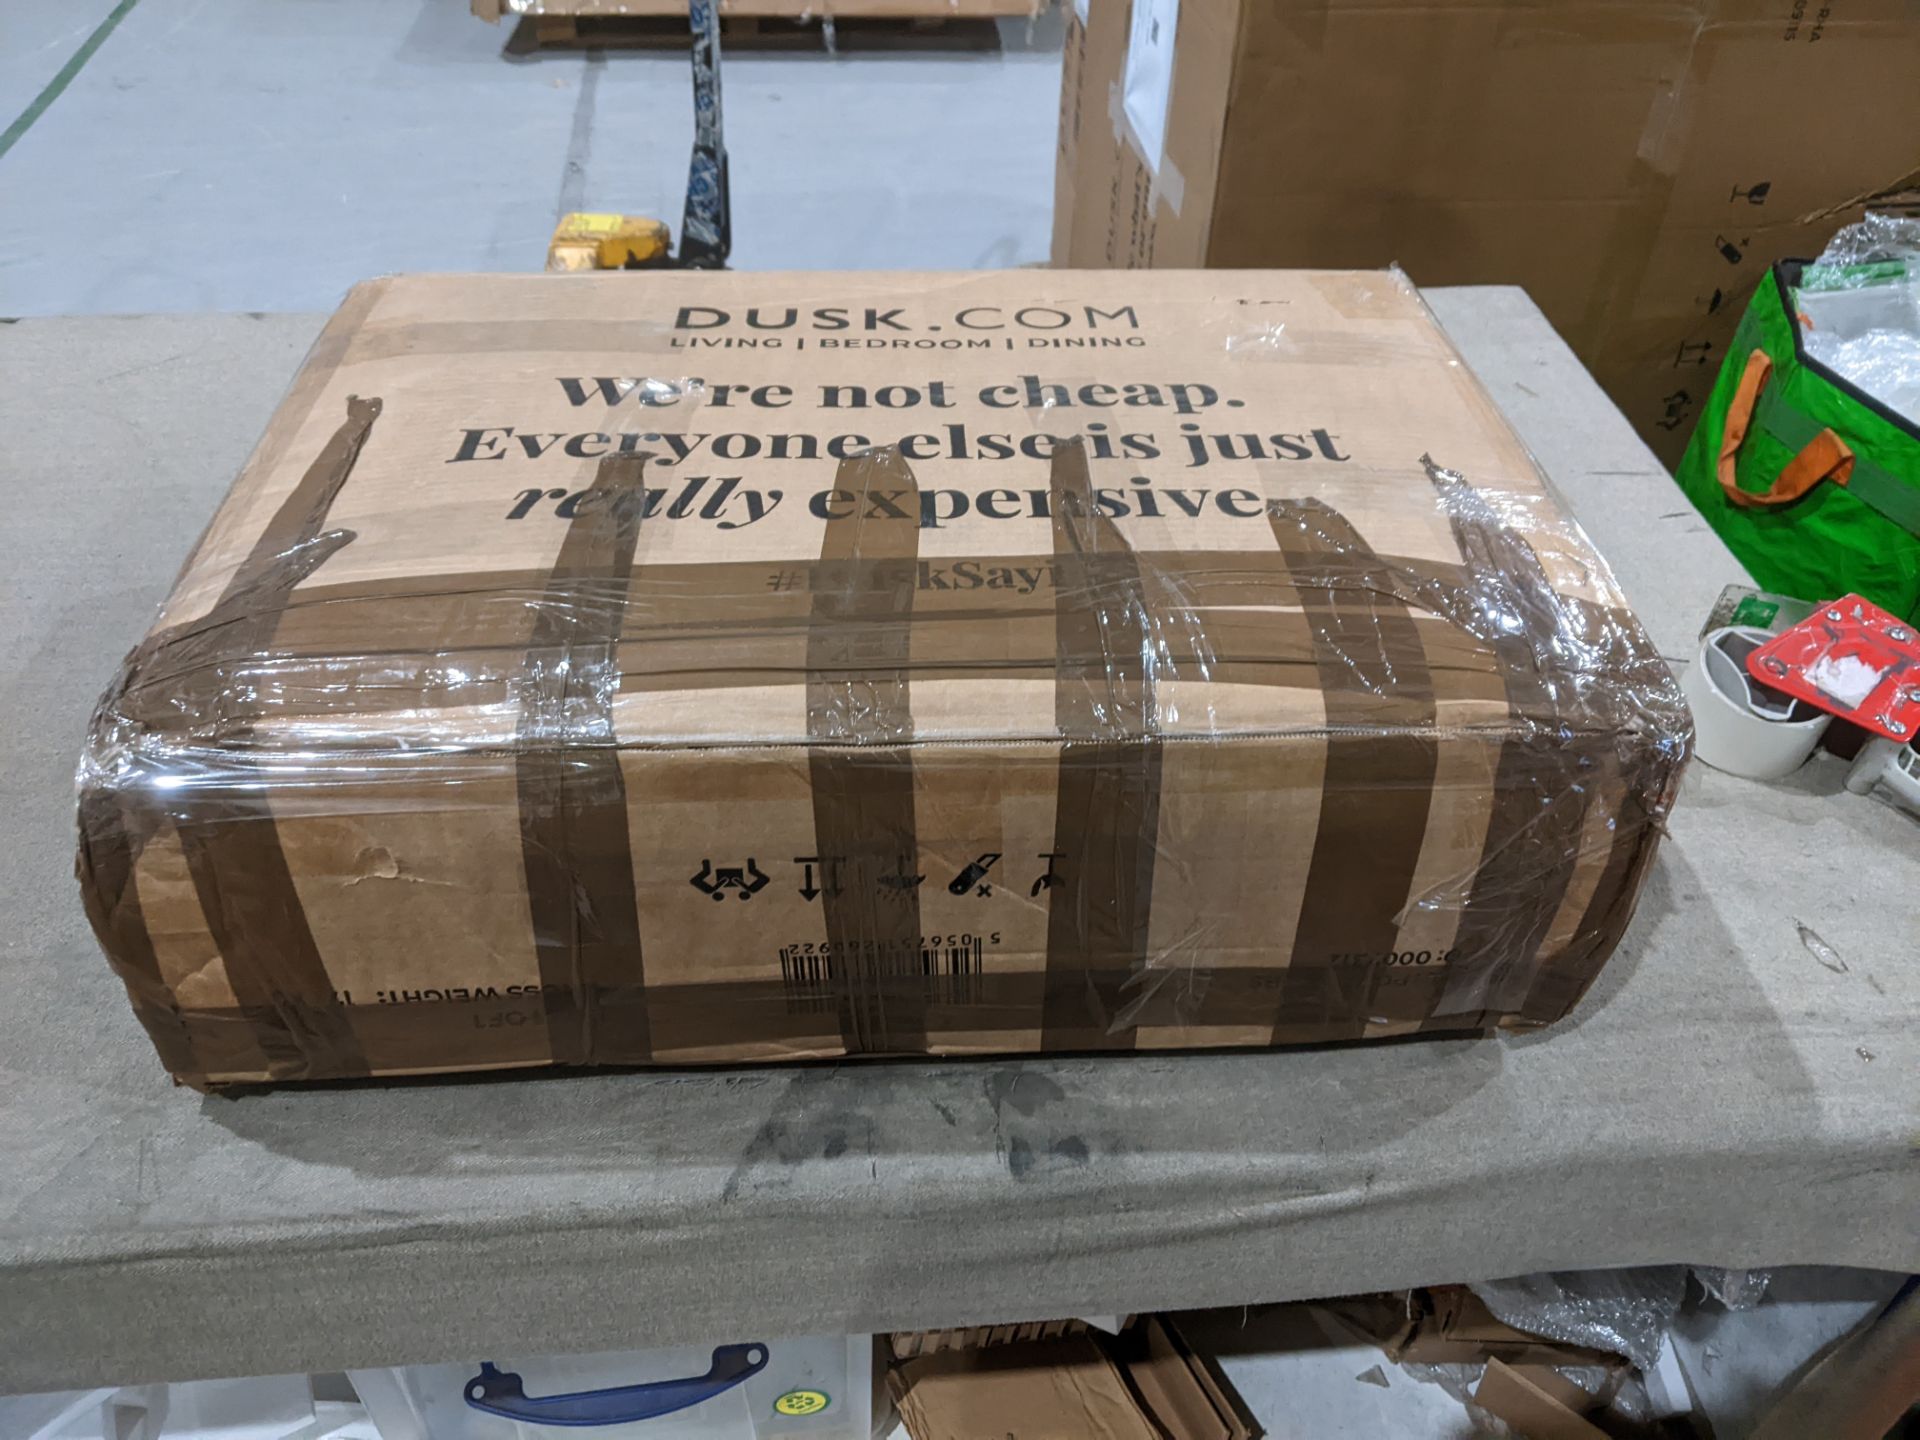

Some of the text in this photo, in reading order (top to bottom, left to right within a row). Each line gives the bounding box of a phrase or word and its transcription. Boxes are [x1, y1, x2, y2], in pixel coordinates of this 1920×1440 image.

[674, 305, 1139, 331] DUSK.COM
[670, 337, 782, 349] LIVING
[819, 337, 991, 349] BEDROOM
[1028, 336, 1146, 348] DINING
[555, 375, 1245, 414] We're not cheap.
[445, 422, 1351, 467] Everyone else is just
